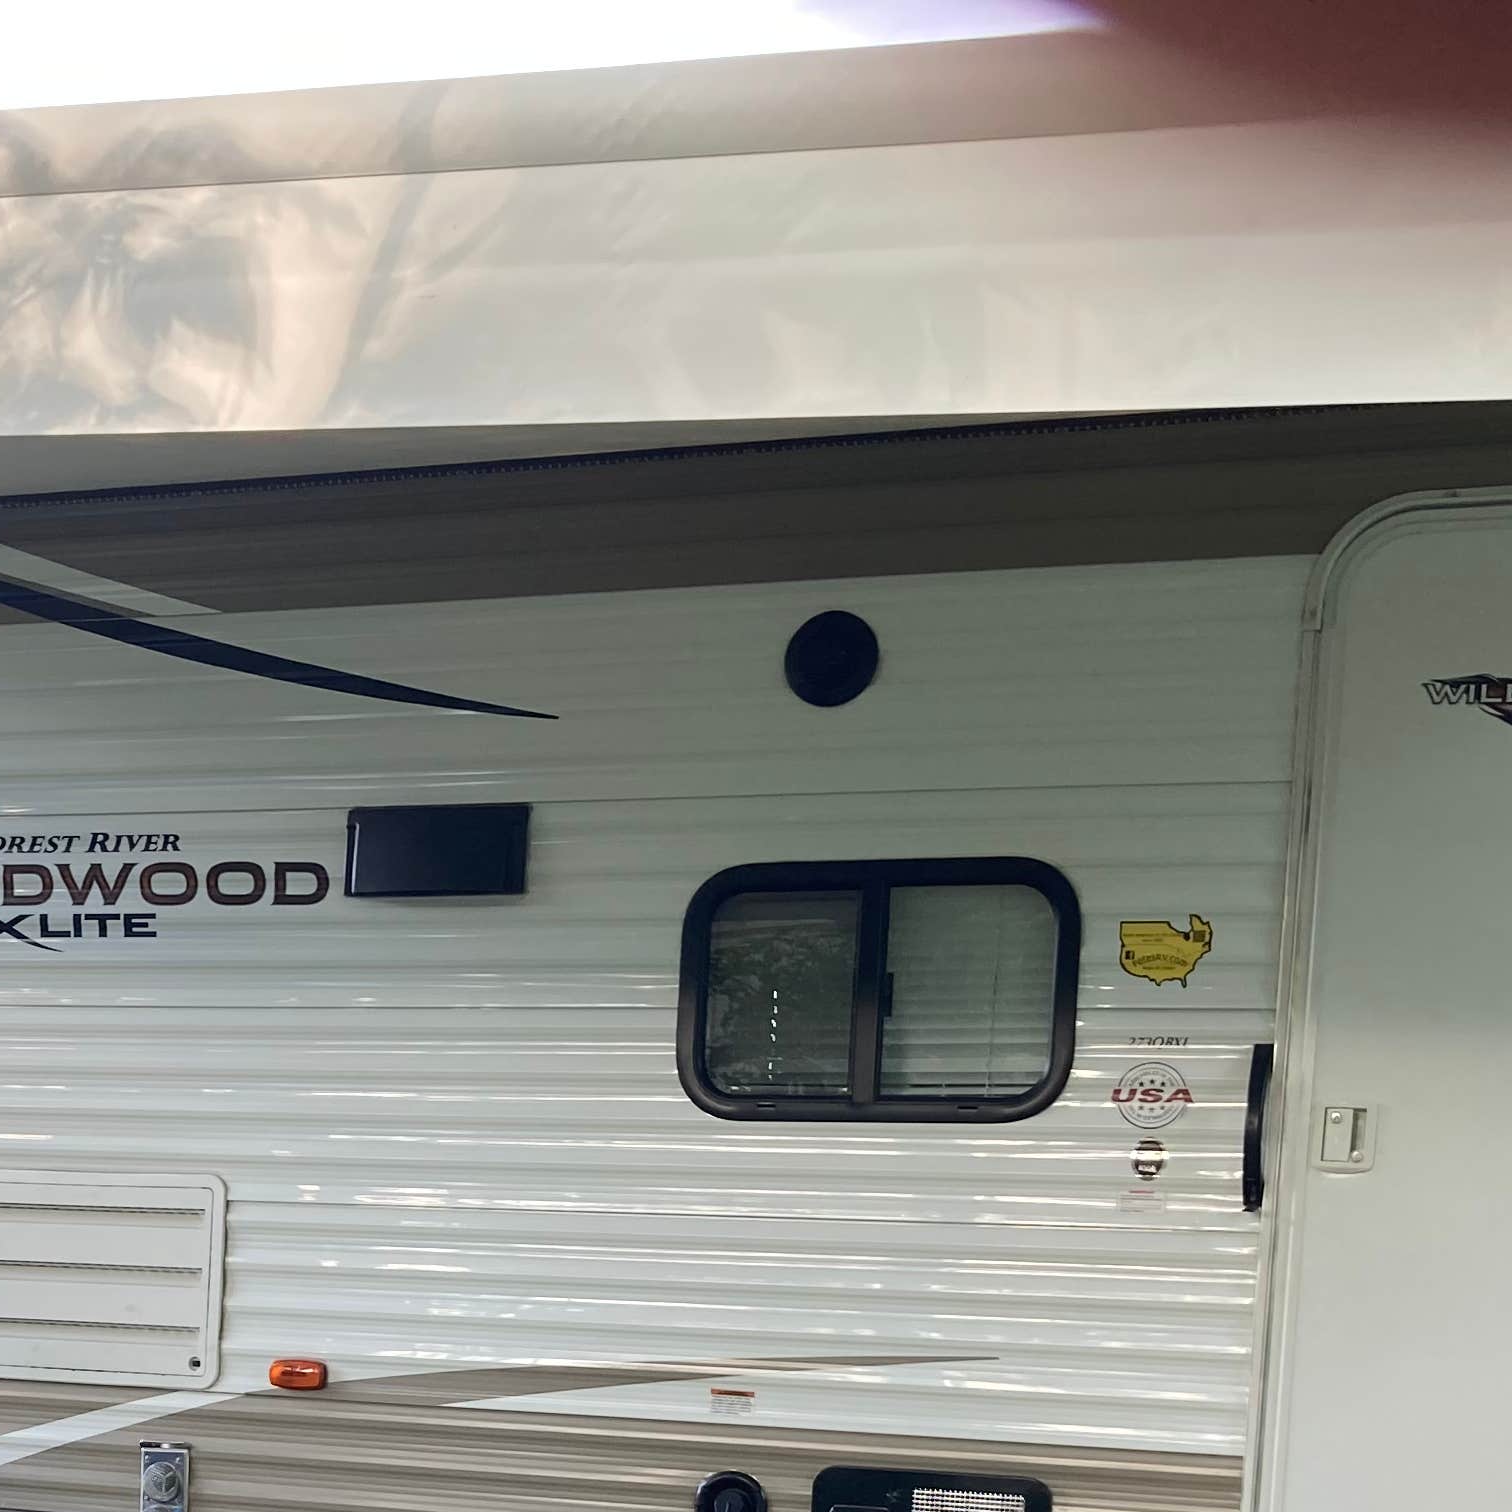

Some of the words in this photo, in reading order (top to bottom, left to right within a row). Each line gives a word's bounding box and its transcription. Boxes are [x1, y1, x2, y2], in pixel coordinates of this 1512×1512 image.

[1421, 681, 1512, 705] WIL
[86, 832, 180, 853] RIVER
[1111, 1088, 1194, 1103] USA
